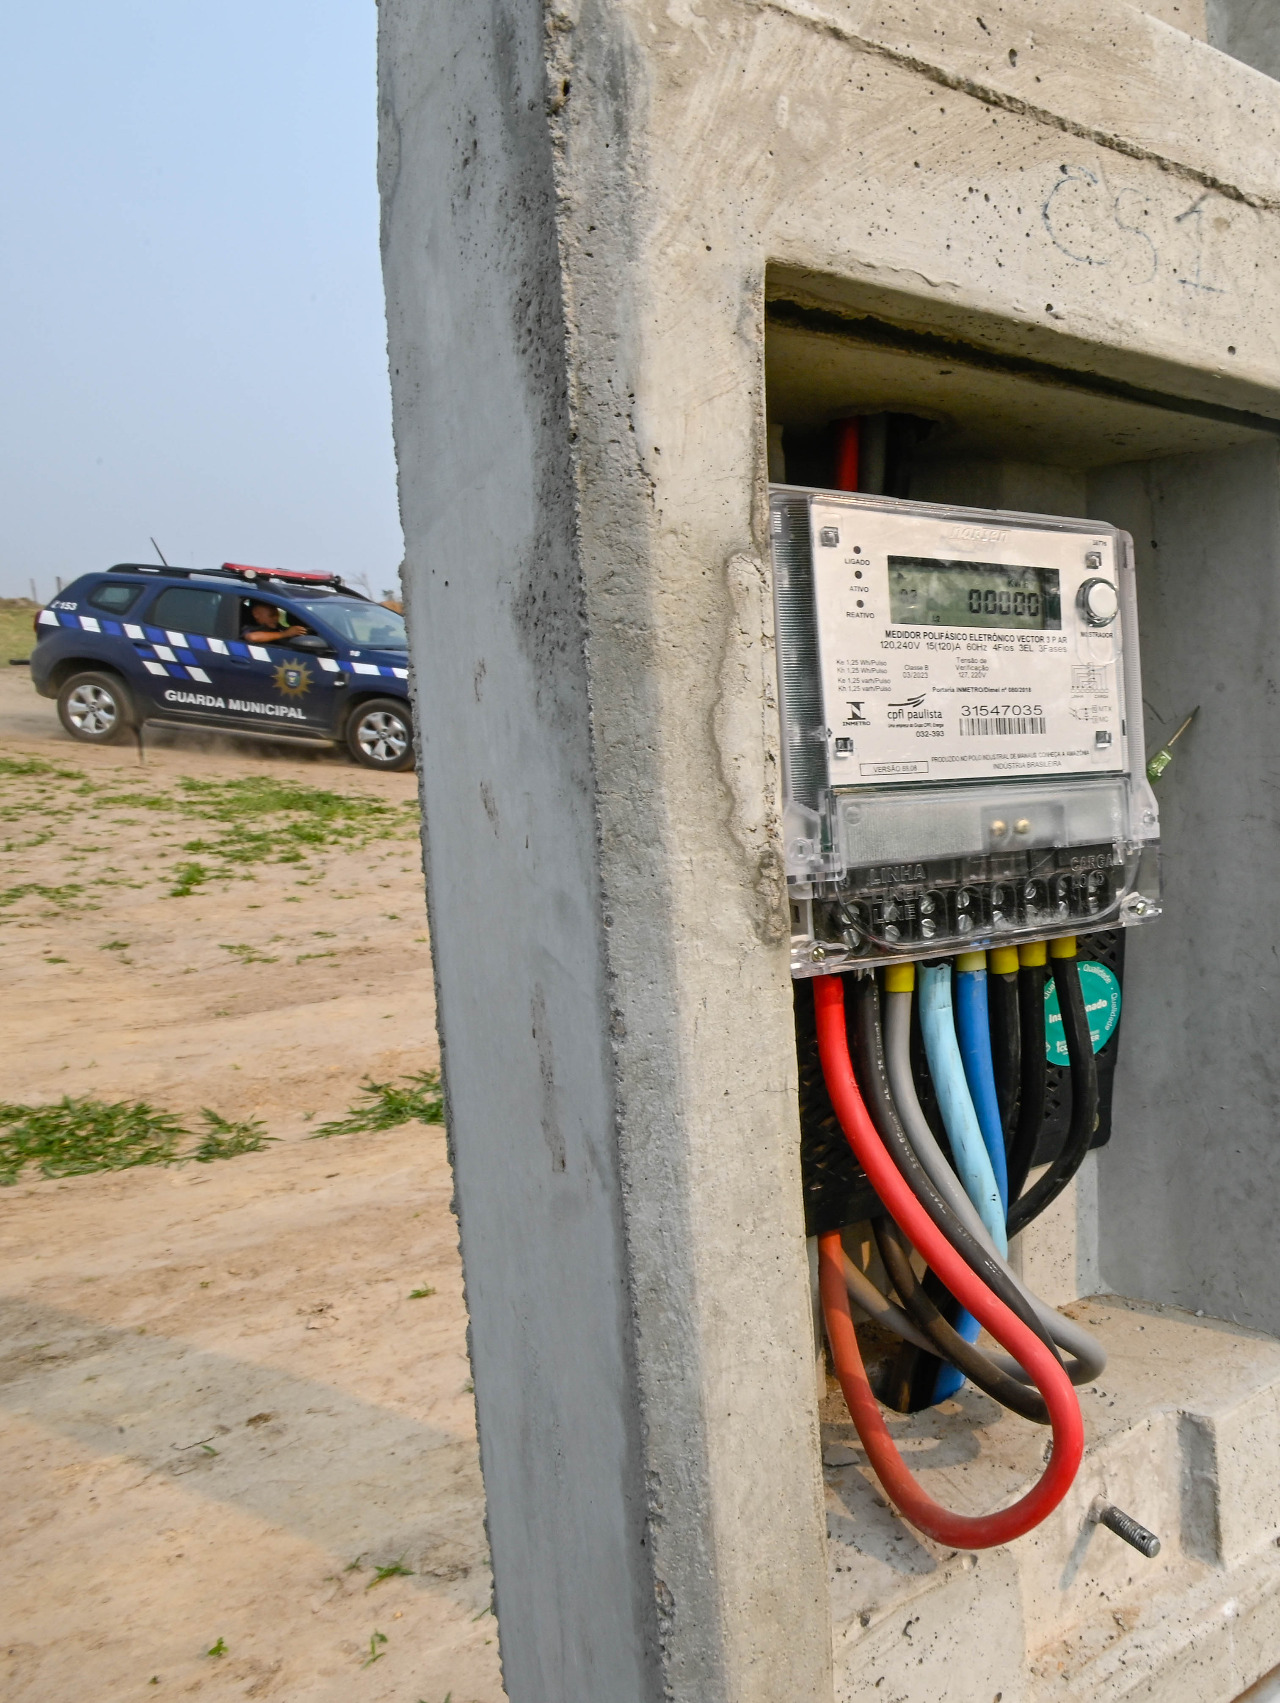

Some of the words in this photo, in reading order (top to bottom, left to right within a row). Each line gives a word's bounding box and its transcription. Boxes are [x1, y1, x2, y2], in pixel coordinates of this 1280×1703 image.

[845, 558, 871, 566] LIGADO
[849, 585, 869, 593] ATIVO
[59, 602, 78, 611] 153
[846, 611, 875, 619] REATIVO
[885, 629, 921, 639] MEDIDOR
[923, 630, 967, 641] POLIFÁSICO
[969, 632, 1015, 643] ELETRÔNICO
[1016, 635, 1044, 643] VECTOR
[1046, 636, 1050, 644] 3
[1080, 631, 1113, 639] MOSTRADOR
[926, 642, 961, 652] 15(120)A
[966, 643, 988, 651] 60Hz
[992, 644, 1015, 652] 4Fios
[1019, 644, 1034, 652] 3EL
[1038, 645, 1068, 653] 3Fases
[956, 656, 978, 664] Tensão
[954, 664, 989, 672] Verificação
[164, 689, 226, 709] GUARDA
[228, 699, 307, 720] MUNICIPAL
[887, 708, 904, 721] cpfl
[907, 708, 943, 721] paulista
[961, 704, 1043, 717] 31547035
[873, 764, 900, 773] VERSÃO
[1027, 760, 1061, 769] BRASILEIRA
[1071, 853, 1114, 872] CARGA
[869, 863, 926, 885] LINHA
[1083, 963, 1112, 984] Qualidade
[1105, 992, 1119, 1031] Qualidade
